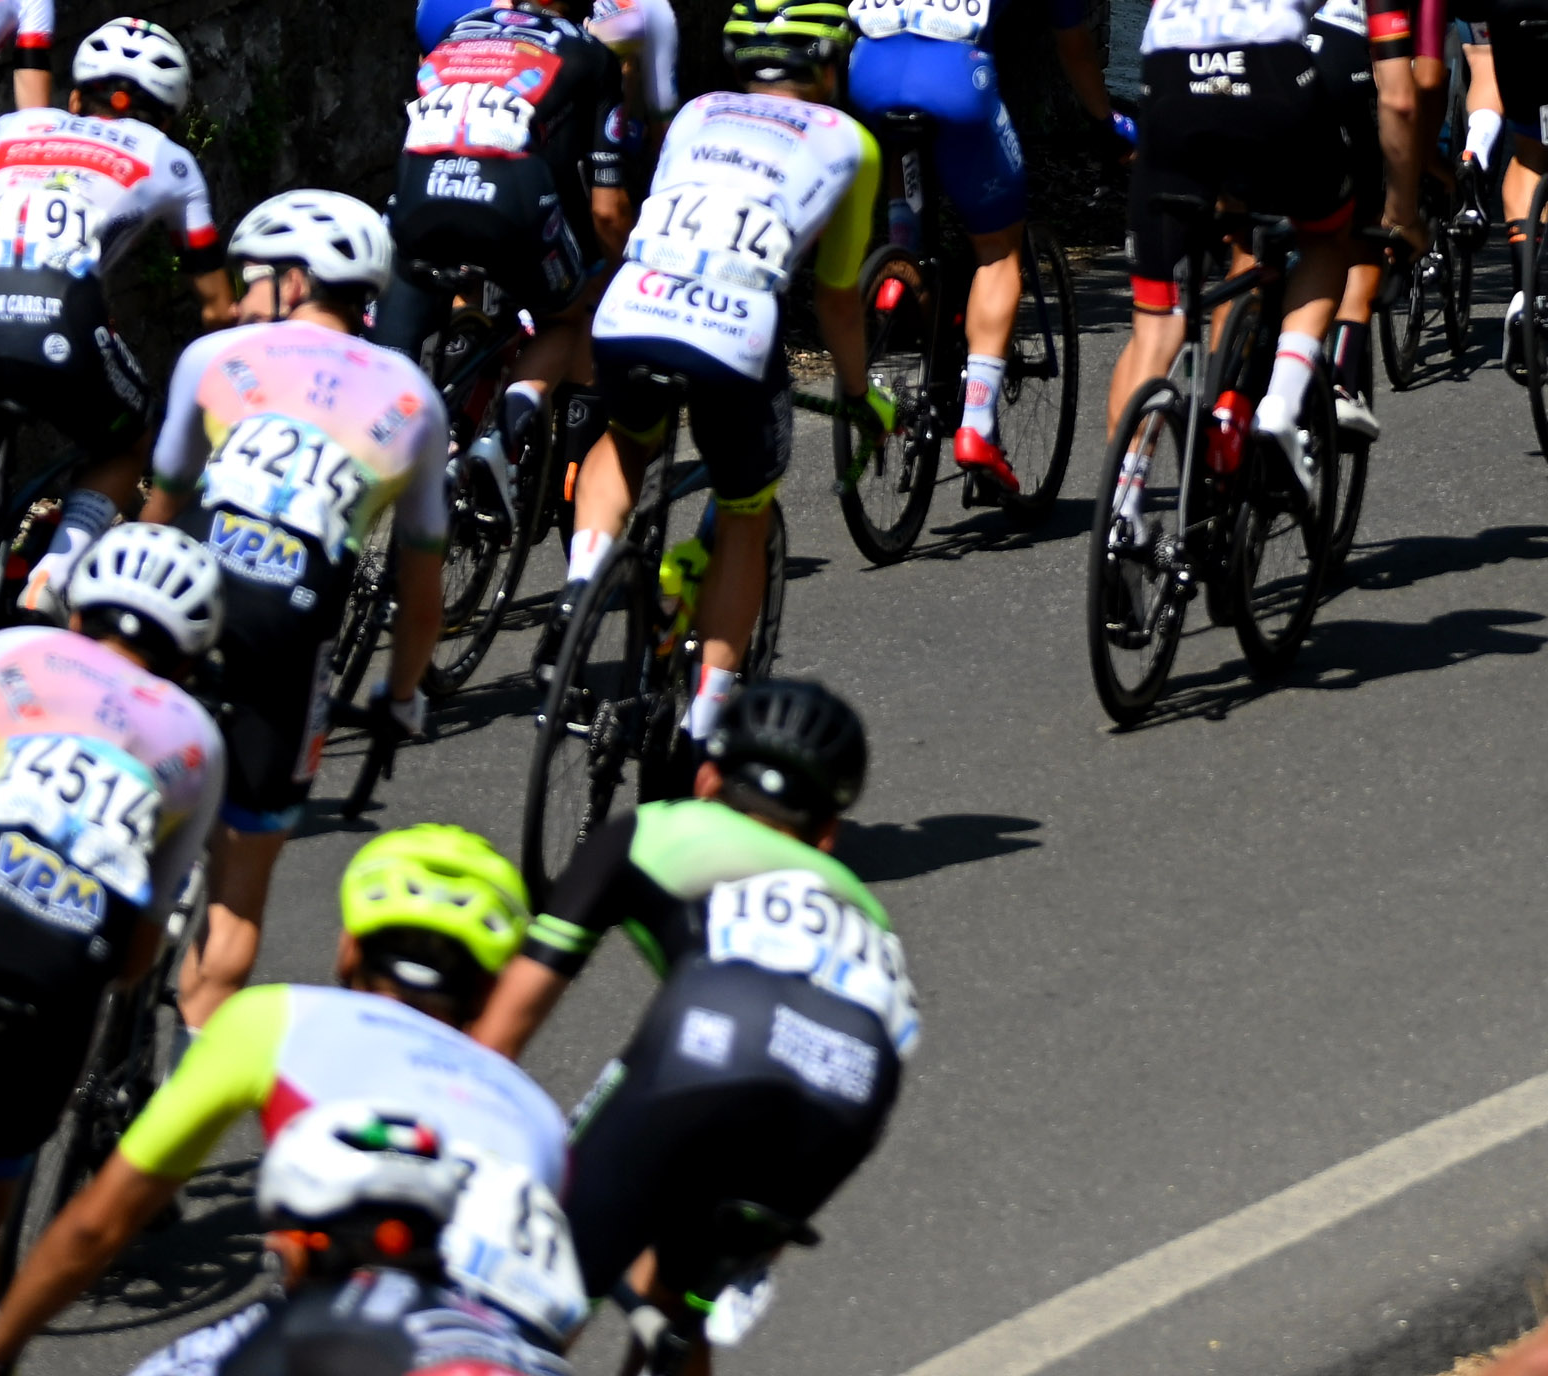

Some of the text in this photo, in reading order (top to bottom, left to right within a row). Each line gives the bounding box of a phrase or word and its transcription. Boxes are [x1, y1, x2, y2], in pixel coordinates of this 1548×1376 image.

[1188, 51, 1247, 75] UAE
[431, 156, 482, 177] selle
[690, 143, 787, 185] Wallonie
[426, 171, 498, 203] italia
[45, 199, 89, 247] 91
[656, 193, 775, 261] 14 14
[6, 294, 64, 317] CARS.IT
[701, 317, 748, 339] SPORT
[210, 510, 308, 576] VPM
[734, 880, 829, 936] 165
